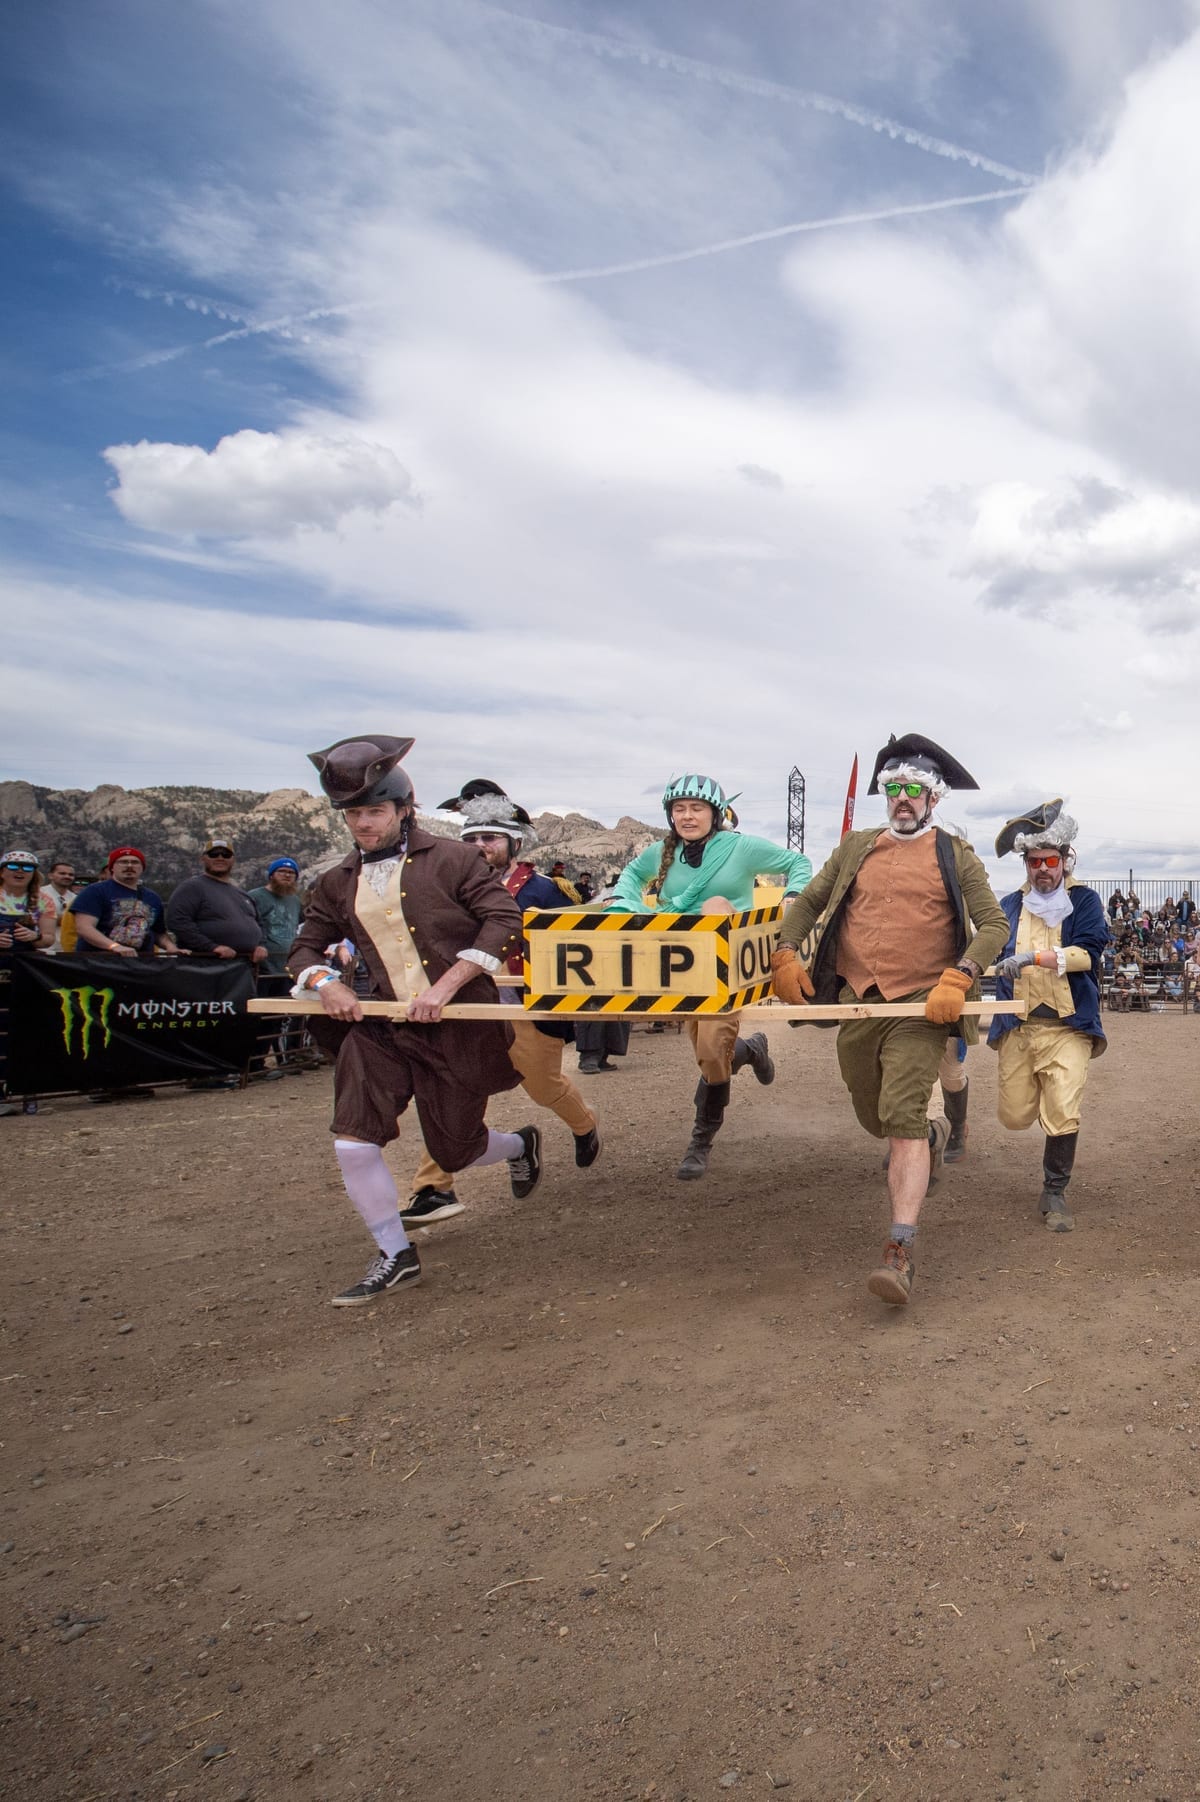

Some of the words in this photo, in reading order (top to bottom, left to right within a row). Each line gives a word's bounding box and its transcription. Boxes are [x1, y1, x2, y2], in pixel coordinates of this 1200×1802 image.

[740, 932, 781, 980] OU
[118, 999, 236, 1019] MONSTER
[137, 1020, 219, 1030] ENERGY
